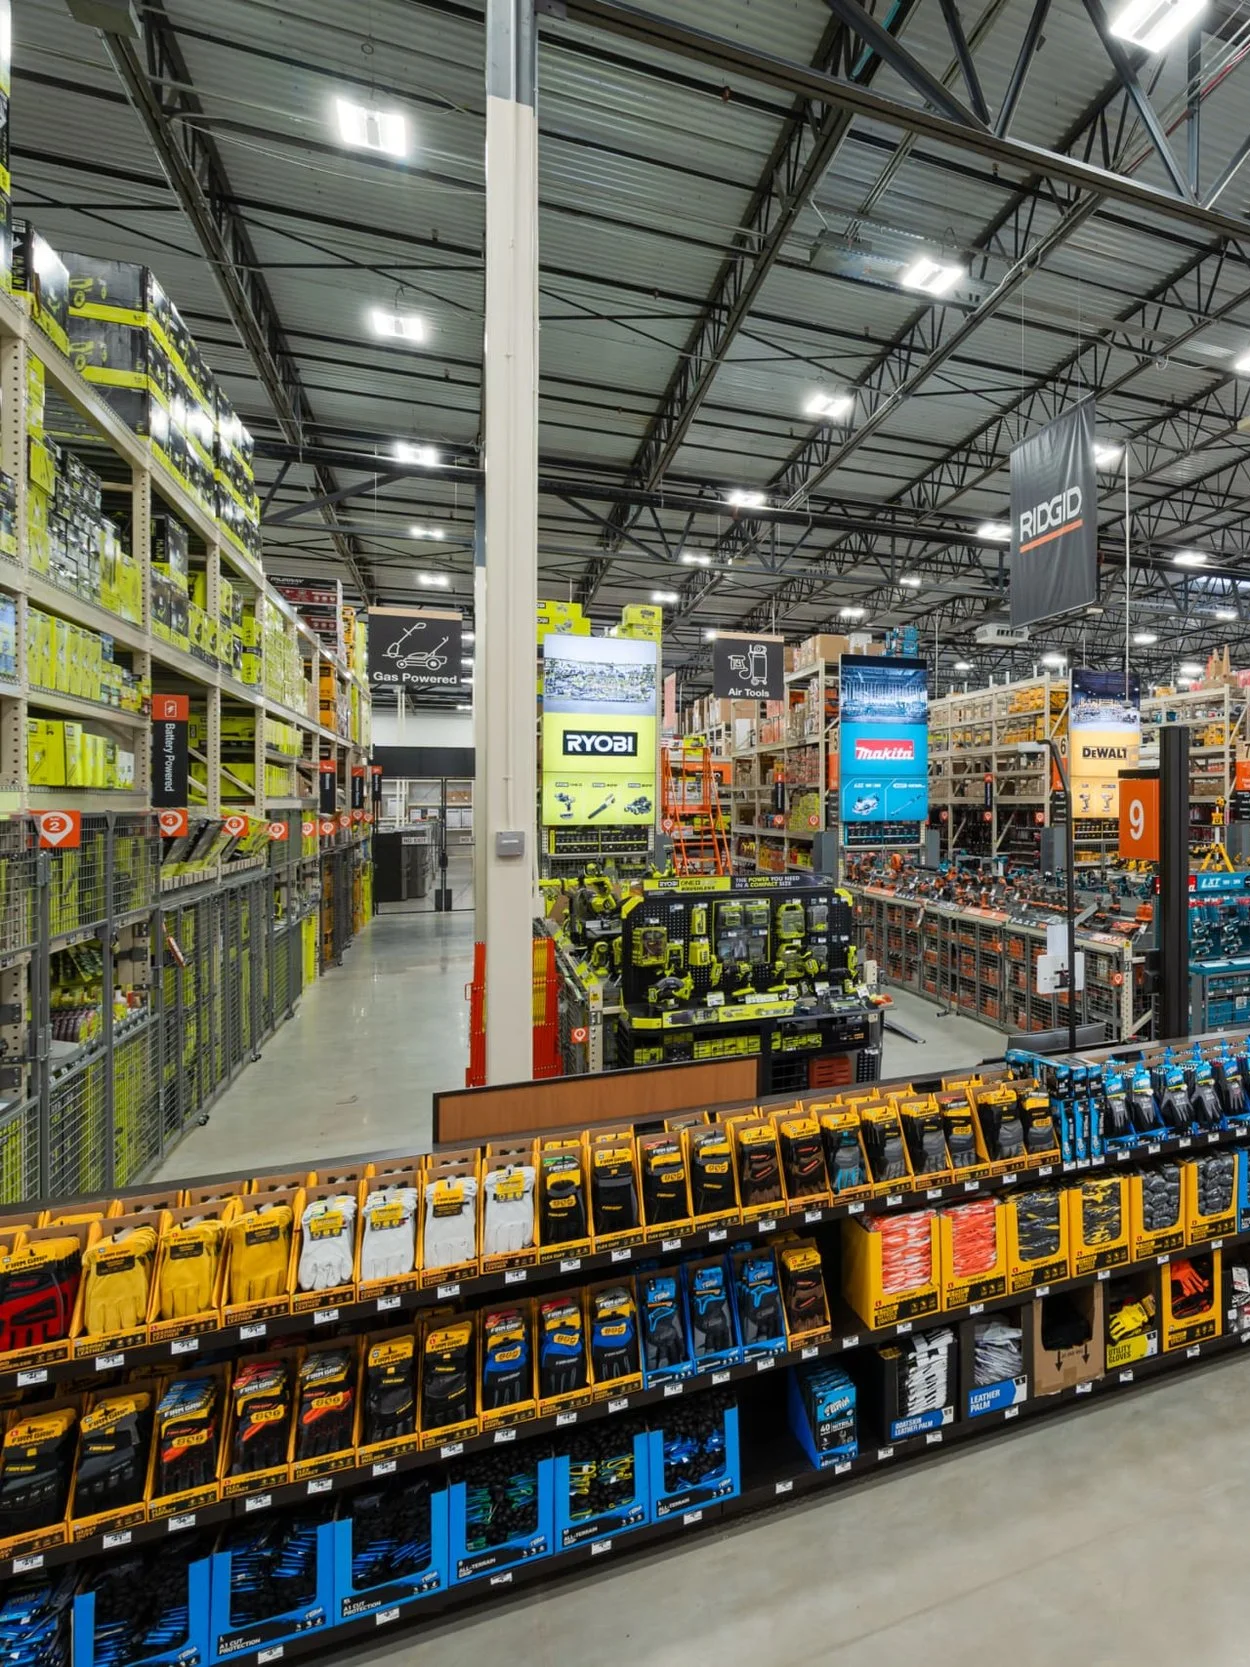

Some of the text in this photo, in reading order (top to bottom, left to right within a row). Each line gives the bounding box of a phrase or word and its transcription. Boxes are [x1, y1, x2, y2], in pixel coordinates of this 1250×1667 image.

[1019, 486, 1082, 542] RIDGID
[373, 671, 458, 684] Gas Powered
[728, 687, 770, 698] Air Tools
[566, 734, 635, 752] RYOBI
[1059, 740, 1067, 755] 6
[1244, 742, 1250, 758] 7
[163, 722, 176, 792] Battery Powered
[166, 817, 174, 826] 4
[1129, 799, 1144, 840] 9
[50, 821, 60, 832] 2
[1201, 878, 1221, 889] LXT
[5, 1260, 26, 1269] FIRM
[1108, 1344, 1131, 1355] UTILITY
[1108, 1351, 1131, 1363] GLOVES
[240, 1384, 259, 1394] FIRM
[970, 1389, 1001, 1404] LEATHER
[164, 1401, 204, 1418] FIRM GRIP
[970, 1401, 991, 1413] PALM
[89, 1407, 129, 1429] FIRM GRIP
[895, 1417, 922, 1430] GOATSKIN
[820, 1424, 831, 1433] 40
[895, 1420, 933, 1436] LEATHER PALM
[11, 1430, 55, 1443] FIRM GRIP
[564, 1526, 598, 1541] ALL-TERRAIN
[459, 1557, 497, 1572] ALL-TERRAIN
[343, 1601, 382, 1617] PROTECTION
[353, 1600, 366, 1610] CUT
[219, 1637, 261, 1655] PROTECTION
[229, 1637, 245, 1647] CUT
